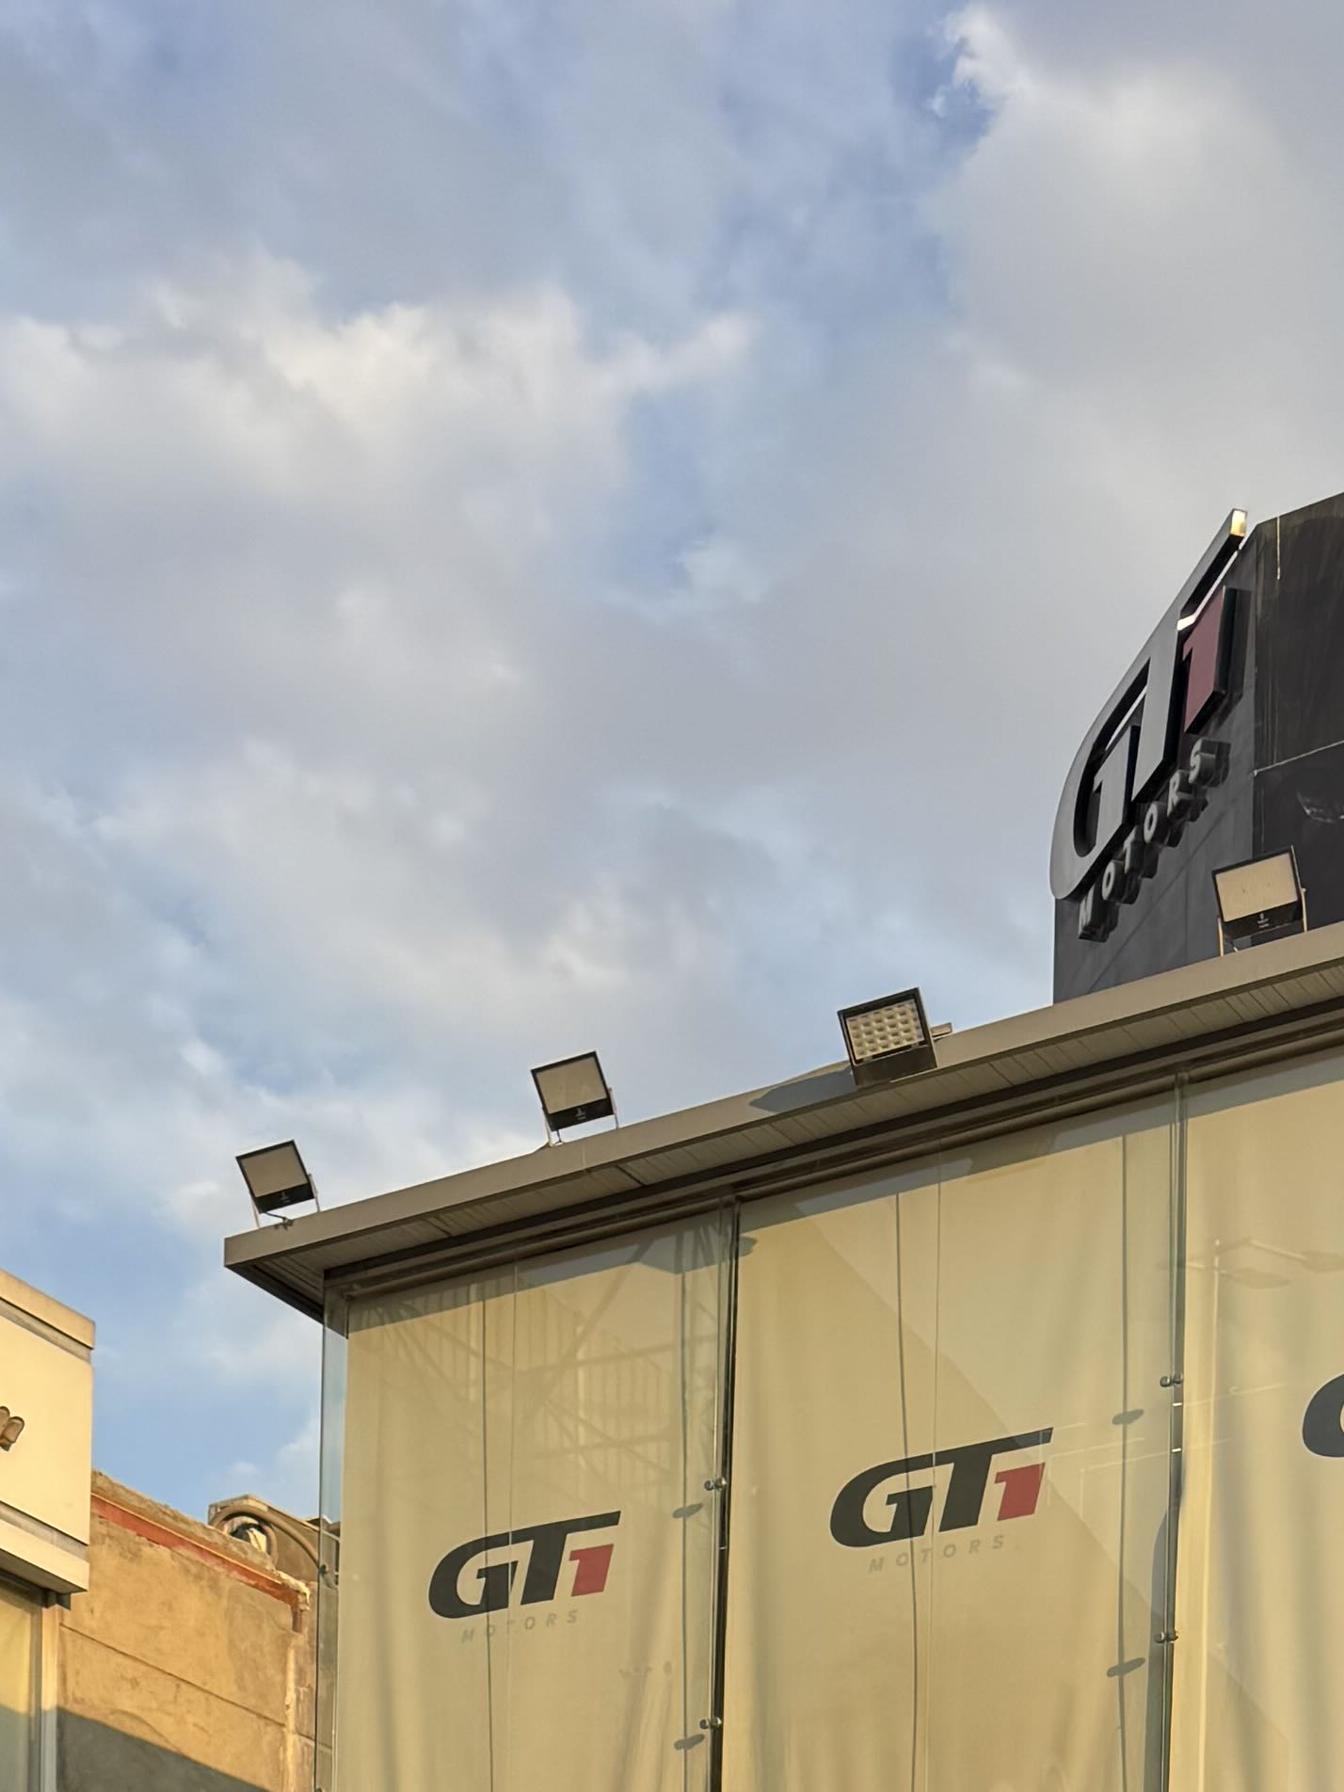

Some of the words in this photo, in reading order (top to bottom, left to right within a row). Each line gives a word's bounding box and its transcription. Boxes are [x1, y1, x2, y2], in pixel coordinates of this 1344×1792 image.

[1078, 738, 1230, 942] MOTORS
[867, 1534, 1005, 1574] MOTORS
[461, 1609, 579, 1645] MOTORS
